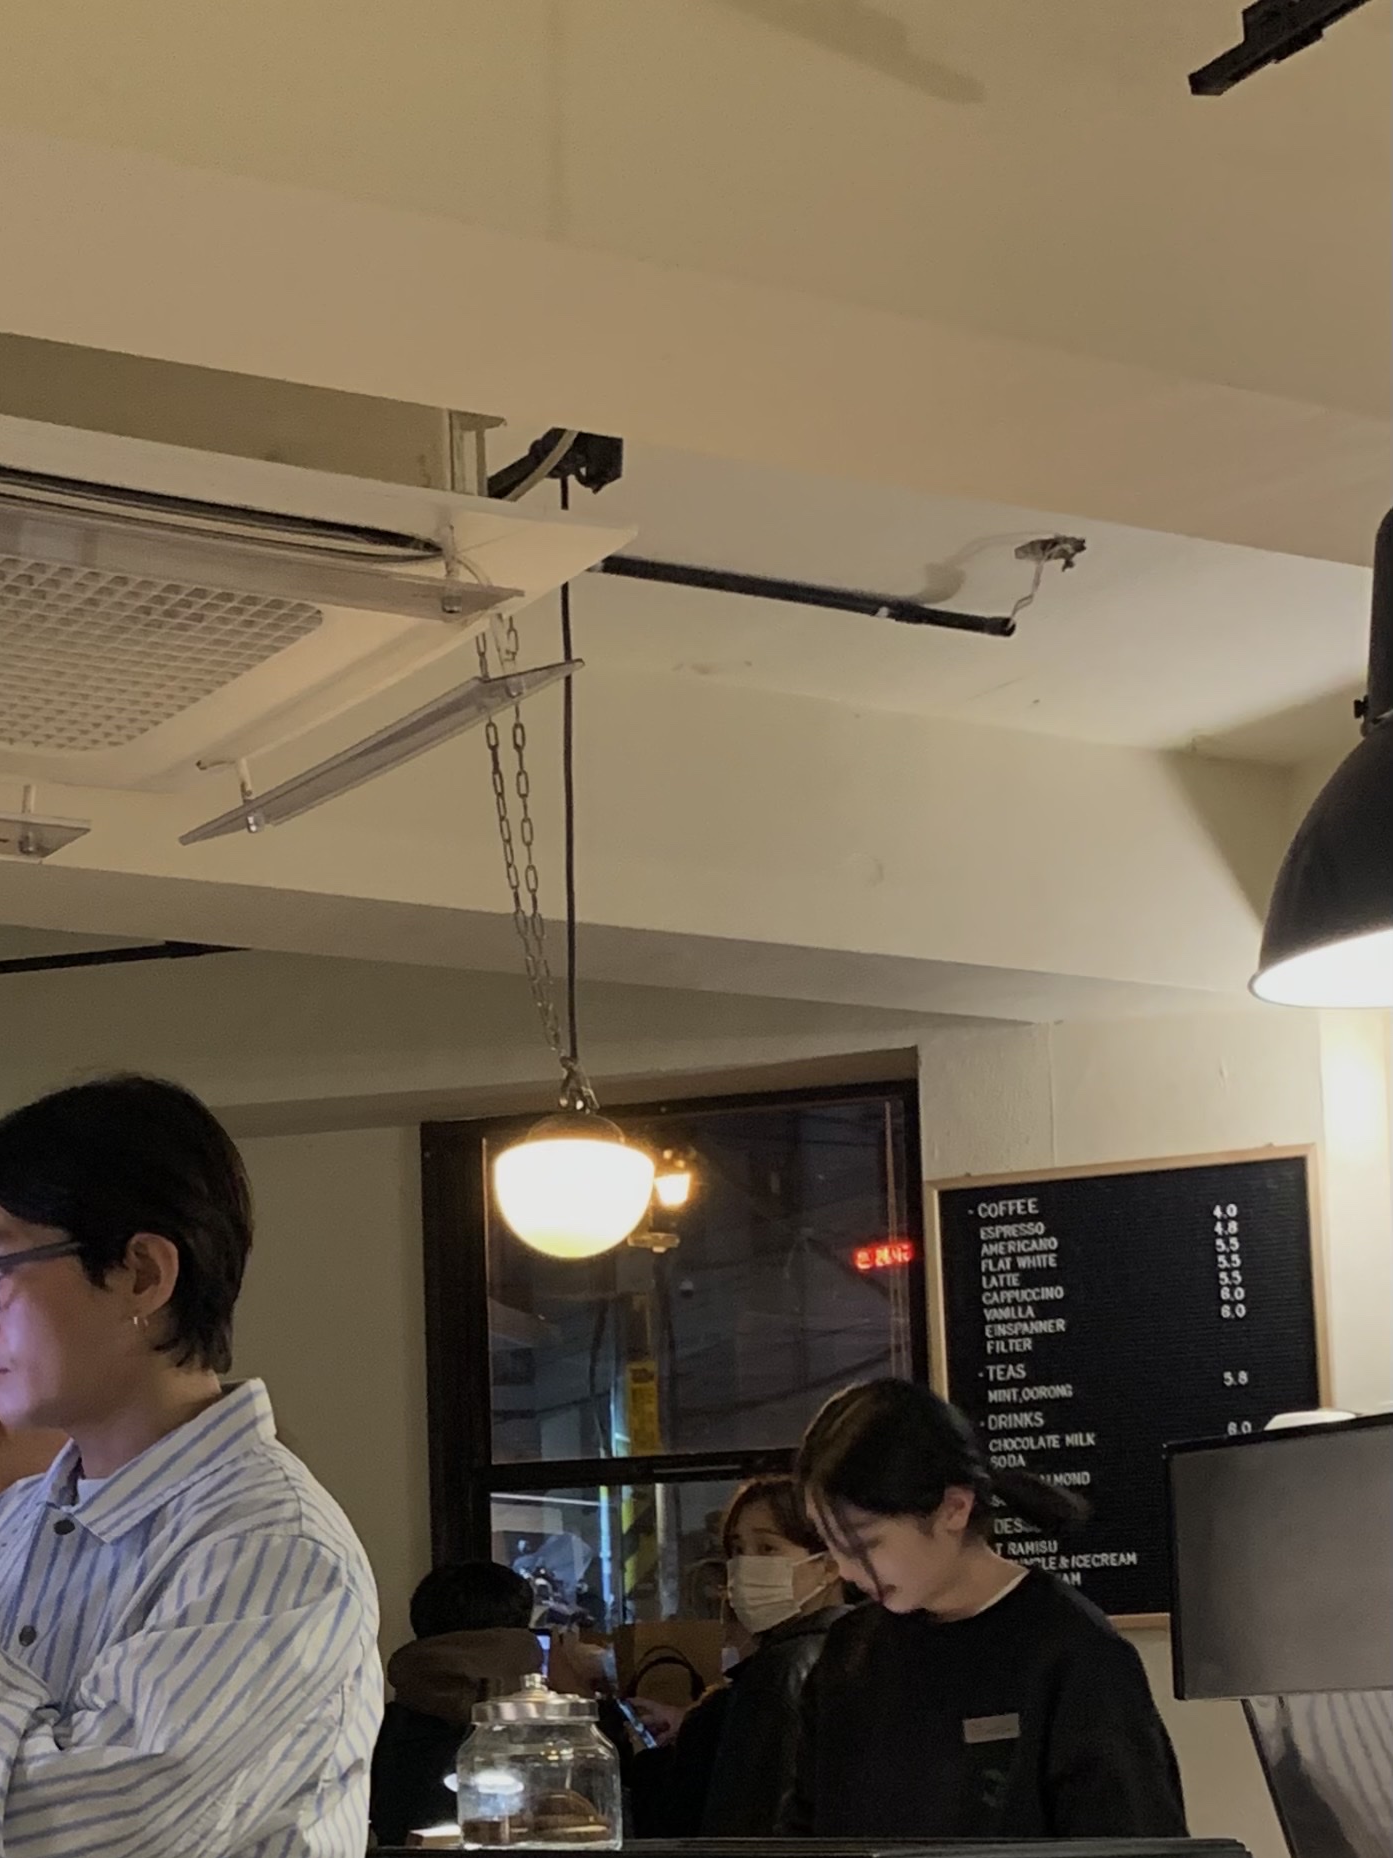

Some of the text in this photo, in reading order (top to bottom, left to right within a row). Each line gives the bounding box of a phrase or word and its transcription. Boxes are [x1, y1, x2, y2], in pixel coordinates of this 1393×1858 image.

[977, 1197, 1039, 1219] COFFEE
[1212, 1203, 1238, 1219] 4.0
[979, 1221, 1045, 1241] ESPRESSO
[981, 1236, 1058, 1257] AMERICANO
[1215, 1236, 1240, 1252] 5.5
[981, 1253, 1058, 1273] FLAT WHITE
[1217, 1253, 1242, 1269] 5.5
[981, 1272, 1020, 1290] LATTE
[1218, 1269, 1243, 1286] 5.5
[981, 1285, 1064, 1305] CAPPUCCINO
[983, 1305, 1036, 1322] VANILLA
[984, 1318, 1066, 1339] EINSPANNER
[986, 1337, 1033, 1355] FILTER
[985, 1363, 1027, 1382] TEAS
[987, 1411, 1045, 1431] DRINKS
[988, 1432, 1096, 1452] CHOCOLATE MILK
[990, 1453, 1026, 1469] SODA
[1071, 1551, 1138, 1568] ICECREAM
